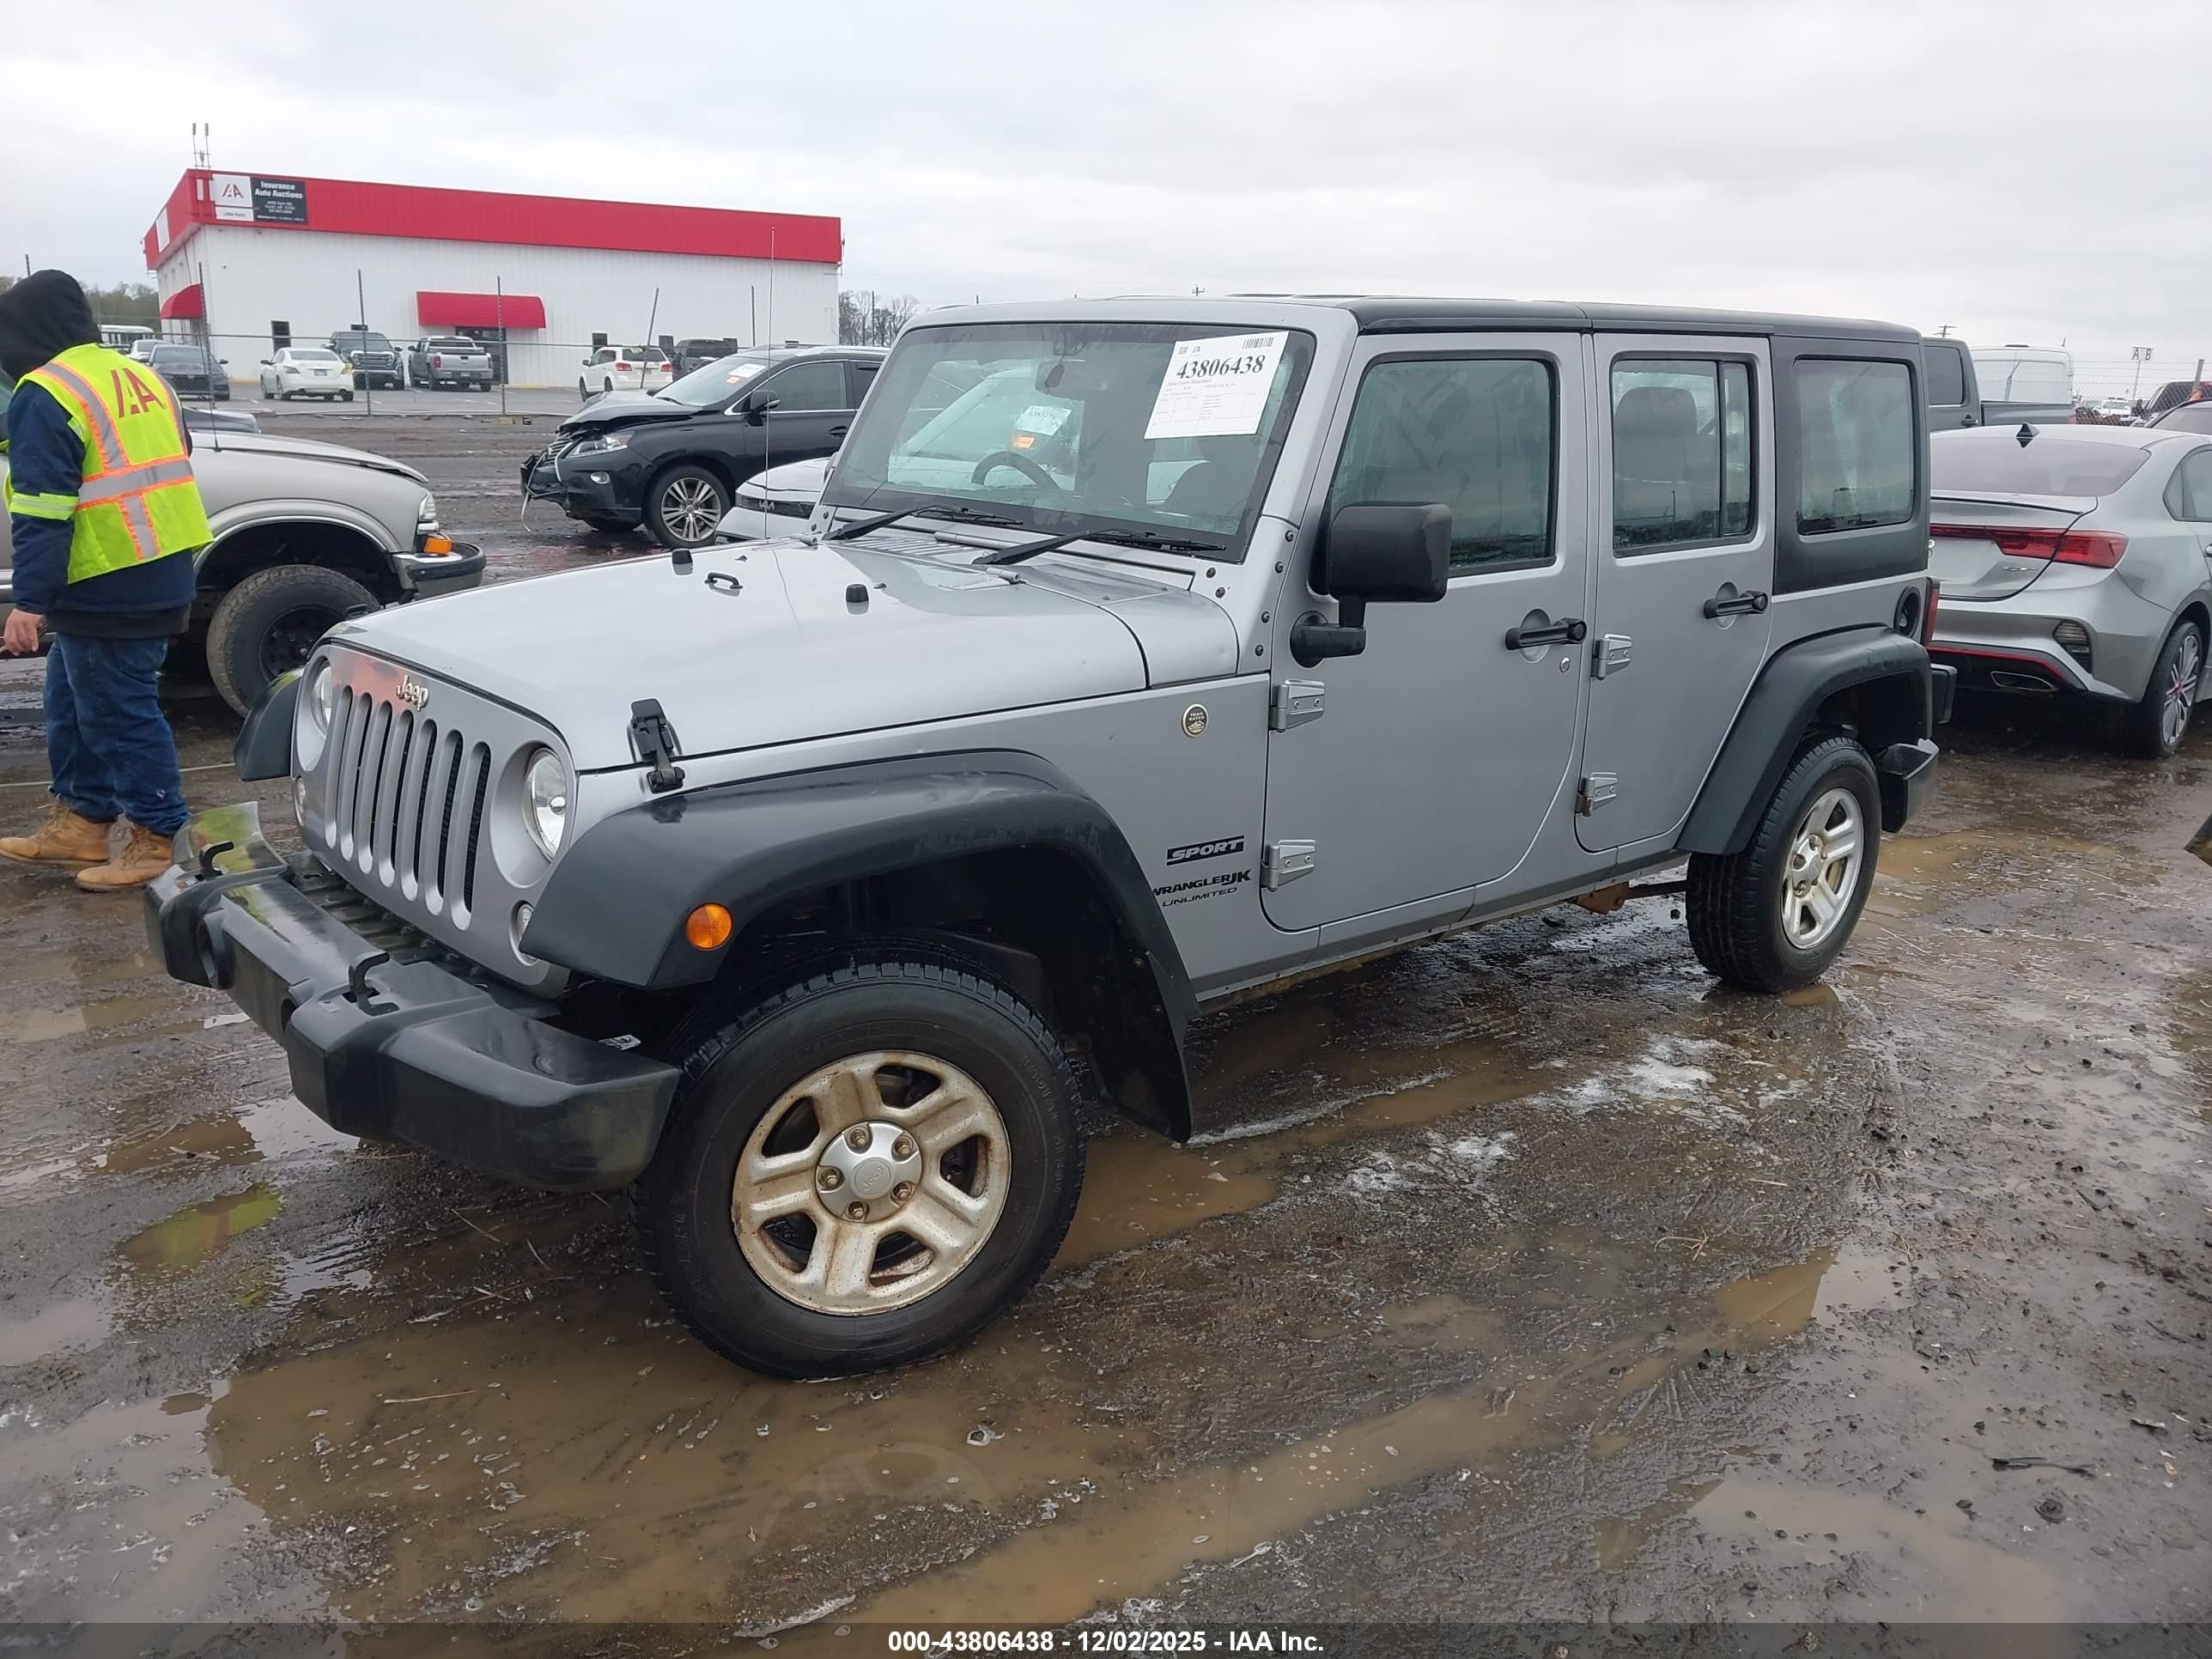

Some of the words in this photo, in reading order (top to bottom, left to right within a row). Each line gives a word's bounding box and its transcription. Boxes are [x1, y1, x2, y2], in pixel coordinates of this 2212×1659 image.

[254, 189, 271, 198] Auto
[272, 190, 304, 199] Auctions
[260, 180, 295, 190] Insurance
[2131, 347, 2139, 361] A
[2145, 348, 2152, 361] B
[1176, 355, 1266, 379] 43806438
[396, 674, 429, 712] Jeep
[1168, 838, 1244, 862] SPORT
[1162, 887, 1237, 907] UNLIMITED
